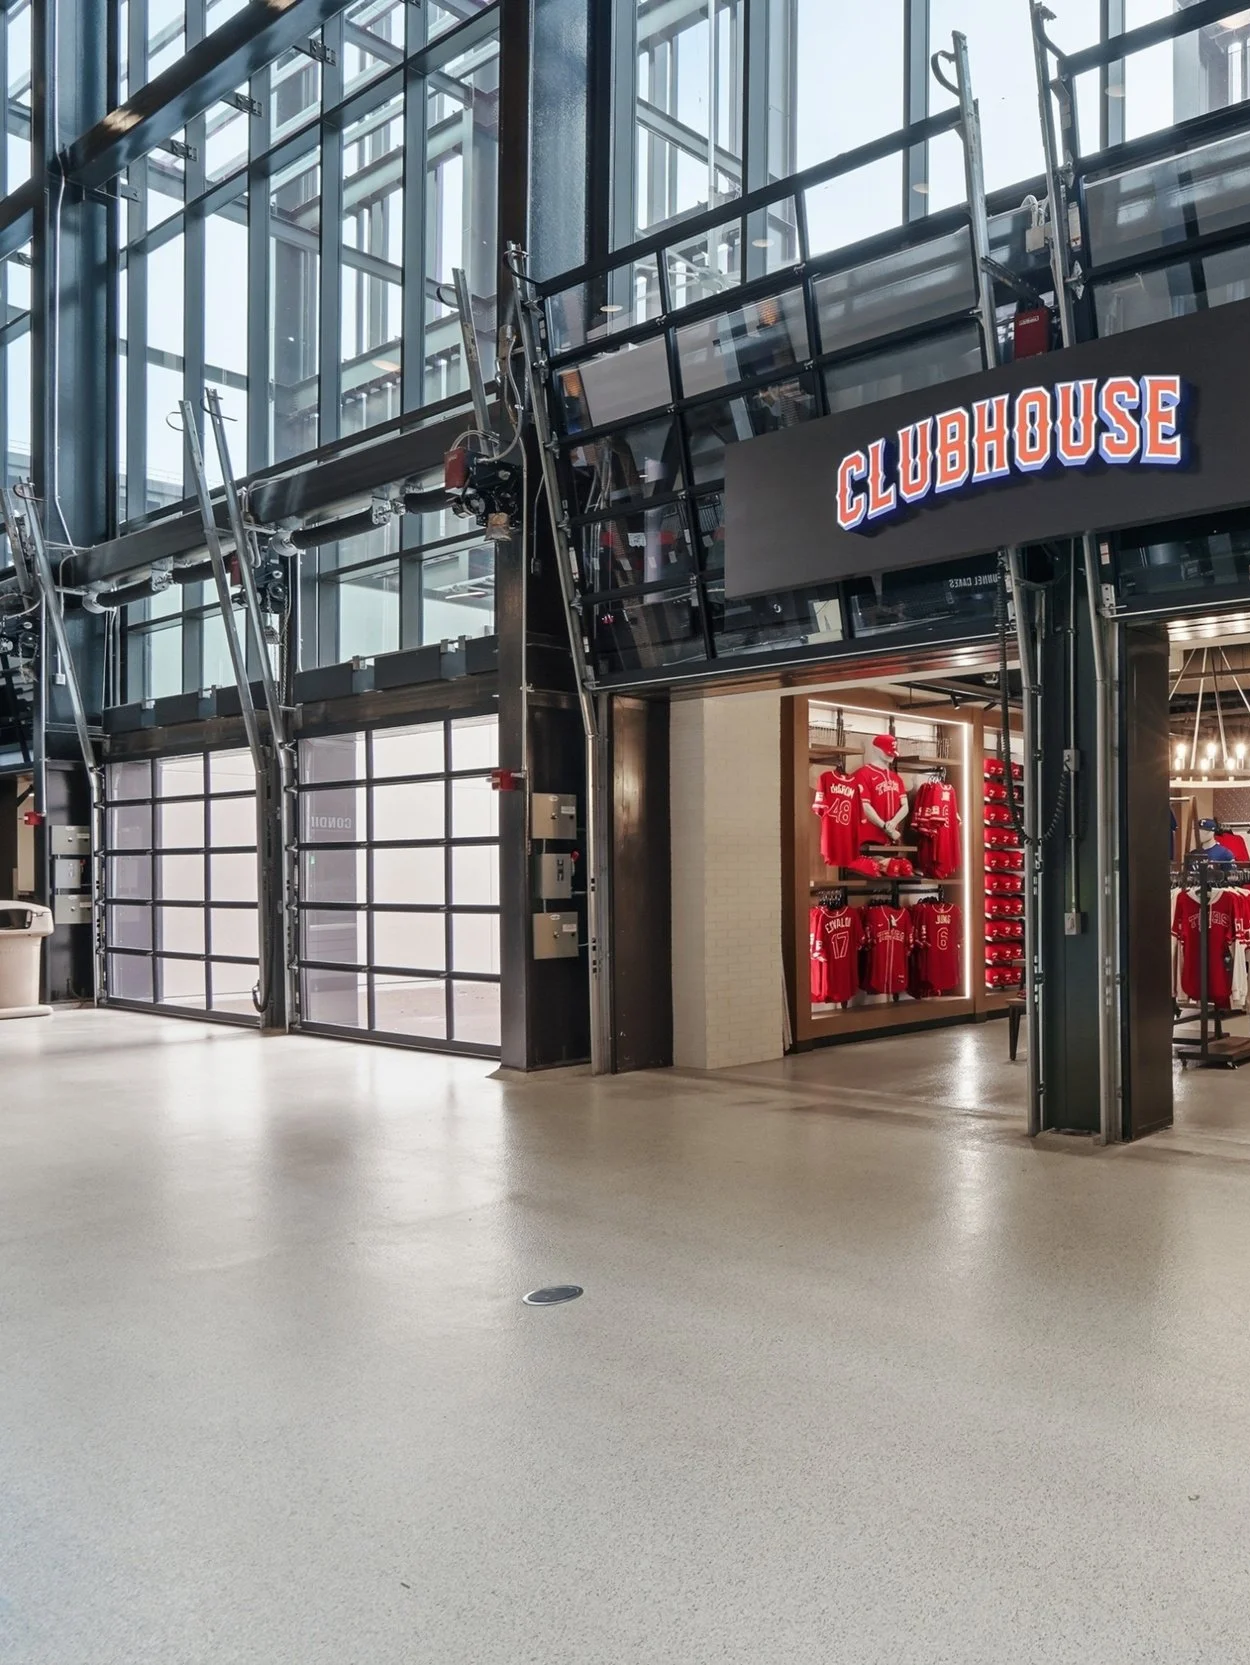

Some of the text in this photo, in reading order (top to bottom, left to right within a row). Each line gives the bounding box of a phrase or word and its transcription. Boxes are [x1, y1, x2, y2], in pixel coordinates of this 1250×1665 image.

[836, 375, 1180, 530] CLUBHOUSE
[827, 797, 851, 826] 48
[831, 930, 850, 960] 17
[936, 926, 949, 951] 6
